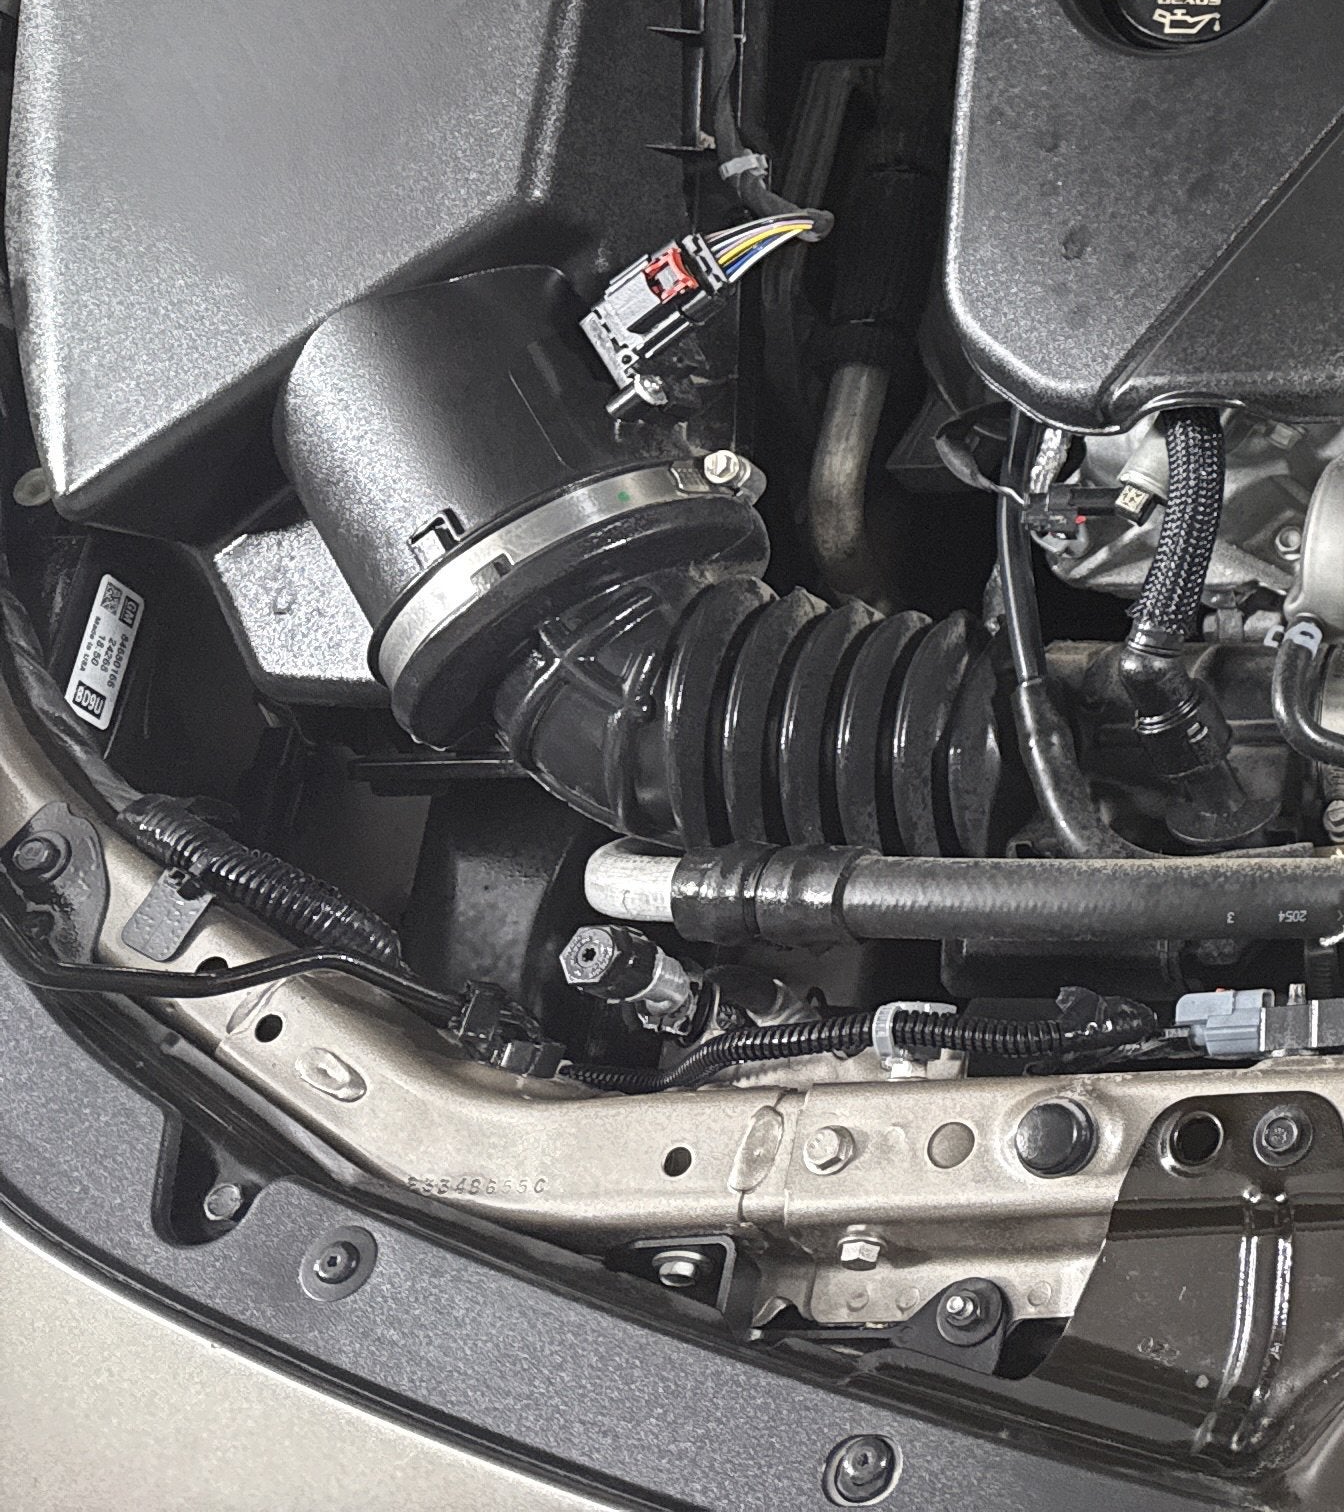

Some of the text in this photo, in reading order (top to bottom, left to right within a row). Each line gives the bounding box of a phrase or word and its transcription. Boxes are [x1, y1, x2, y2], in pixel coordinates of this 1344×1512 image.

[121, 599, 138, 626] GM
[89, 615, 101, 640] Made
[79, 653, 90, 672] USA
[1278, 909, 1308, 923] 2054
